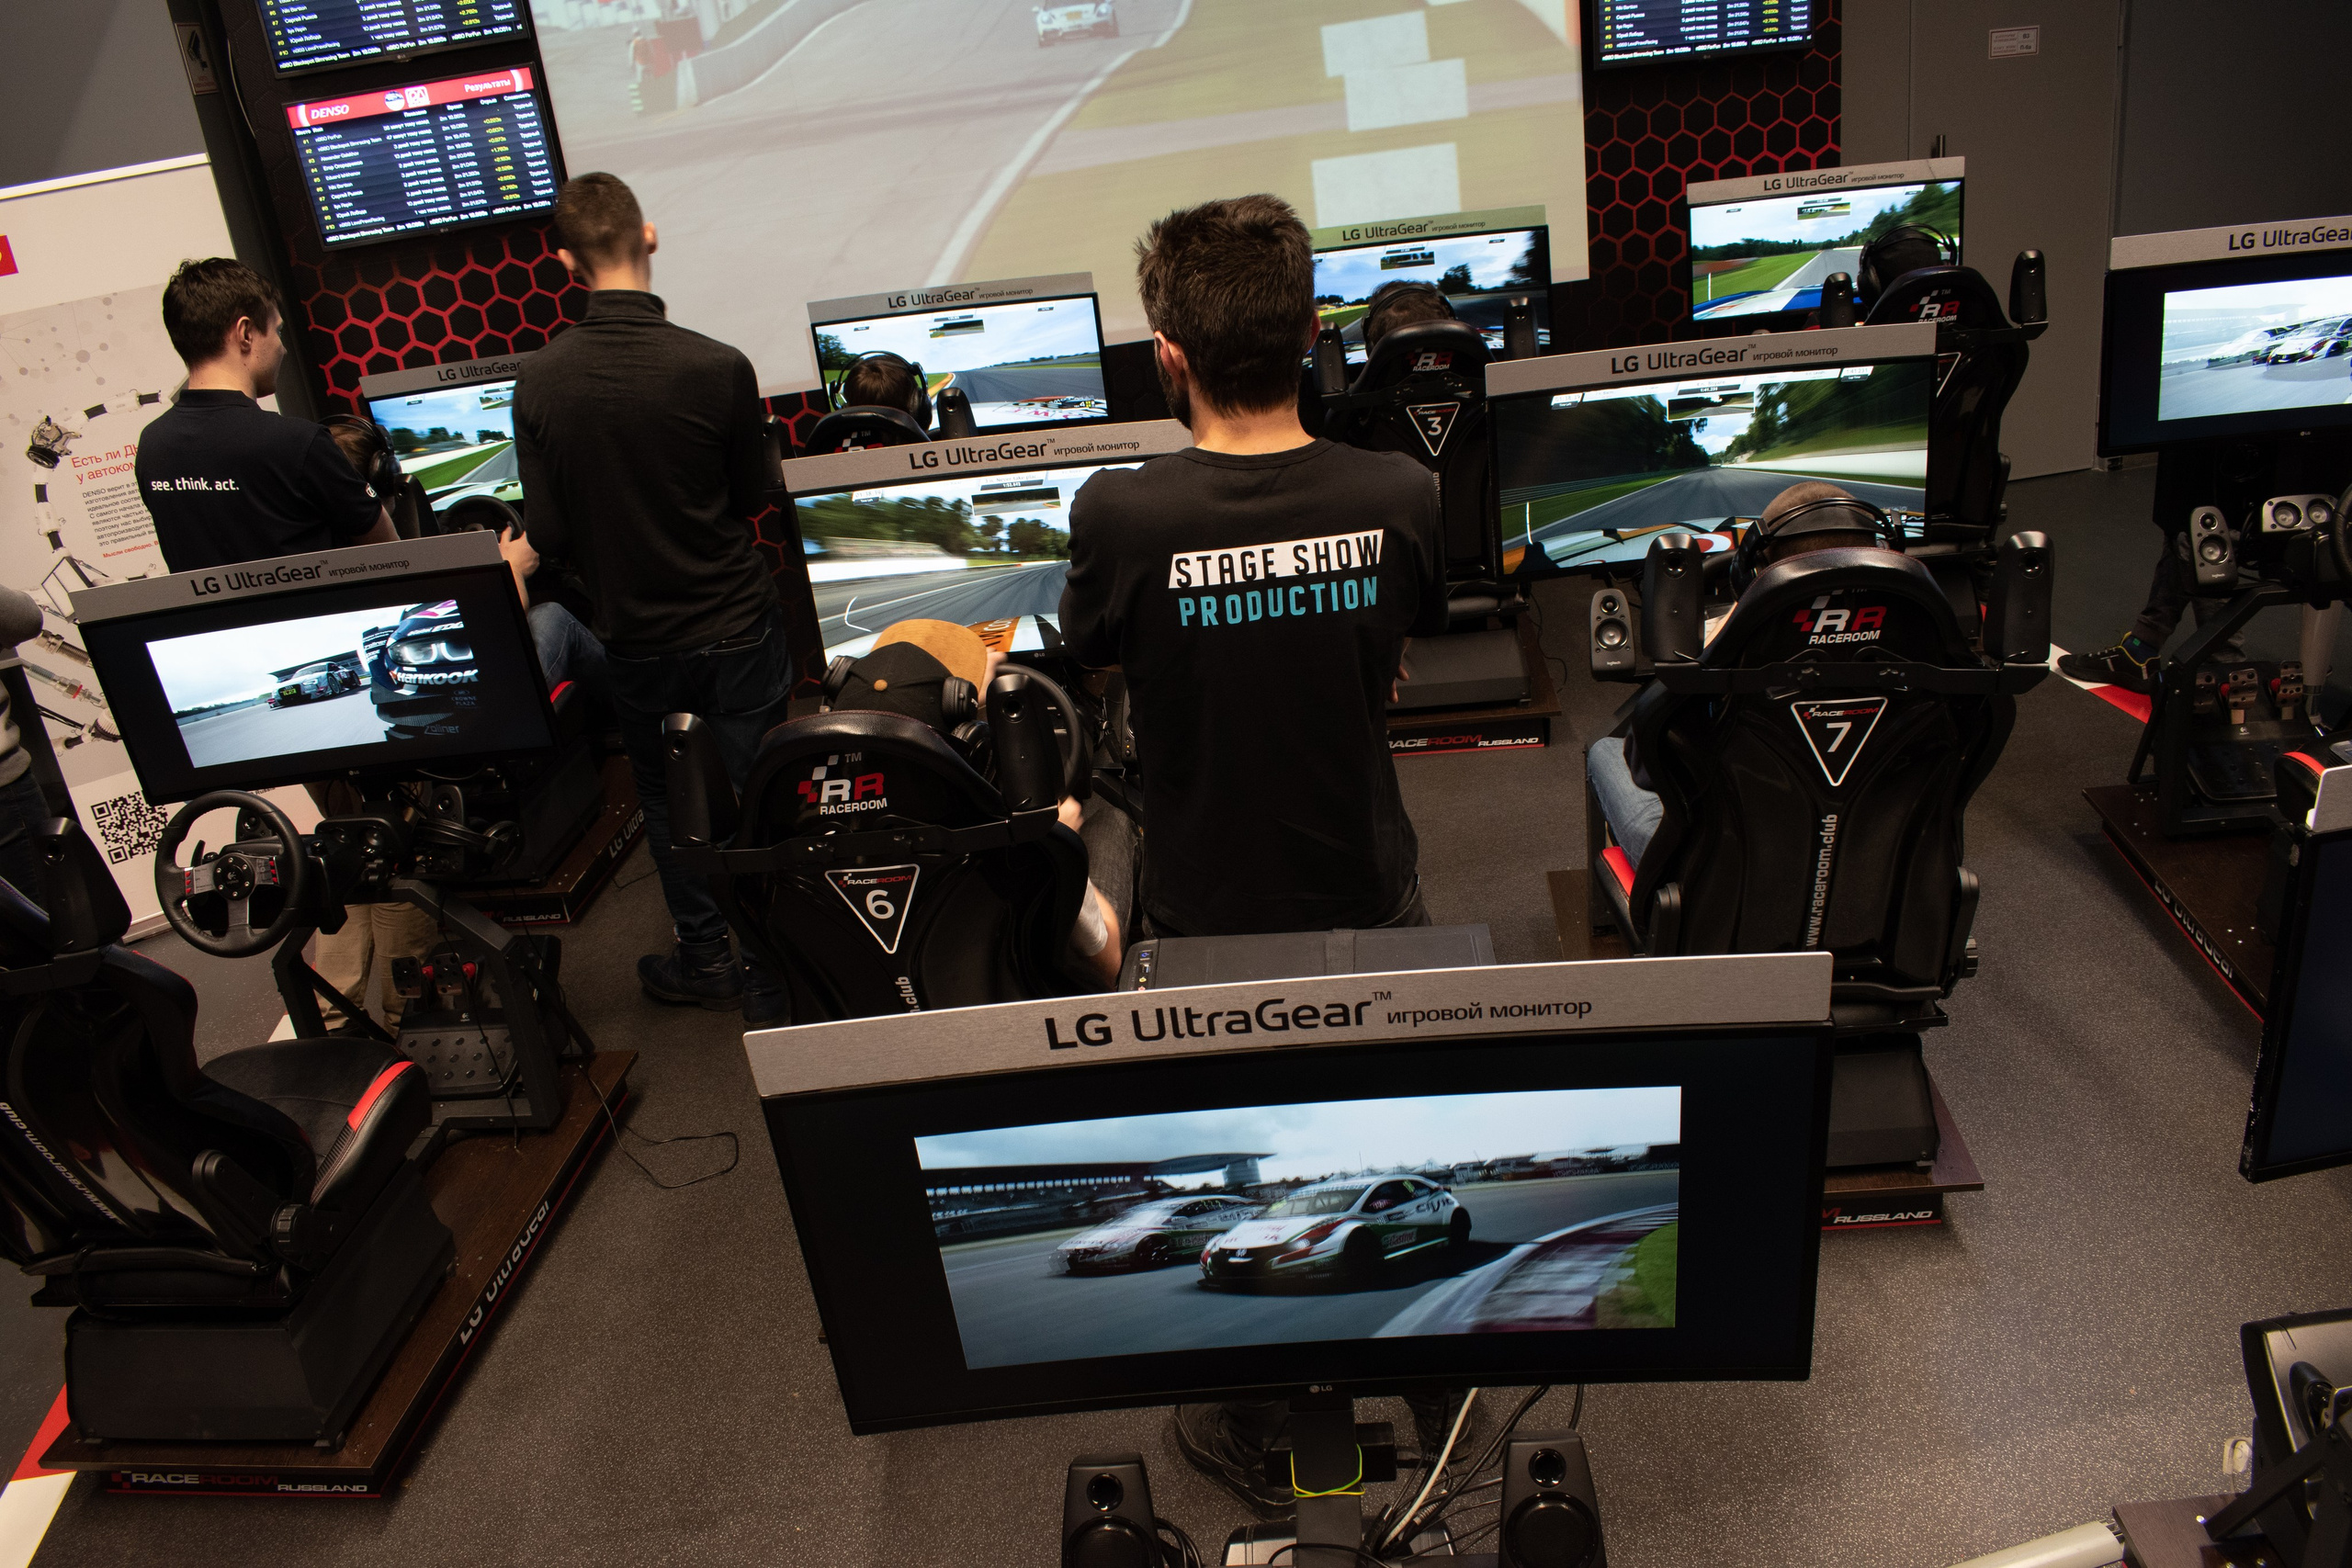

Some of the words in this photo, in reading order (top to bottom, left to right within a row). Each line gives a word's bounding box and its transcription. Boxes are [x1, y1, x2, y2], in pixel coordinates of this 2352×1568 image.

[463, 79, 511, 93] Результаты
[311, 104, 350, 119] DENSO
[1764, 178, 1781, 191] LG
[1851, 174, 1877, 184] игровой
[1877, 172, 1905, 181] монитор
[1342, 229, 1361, 242] LG
[1431, 223, 1457, 232] игровой
[1457, 220, 1487, 231] монитор
[2228, 232, 2256, 251] LG
[888, 296, 907, 309] LG
[978, 289, 1005, 300] игровой
[1005, 287, 1034, 298] монитор
[1413, 364, 1450, 372] RACEROOM
[1611, 355, 1639, 375] LG
[1753, 347, 1793, 363] игровой
[1794, 345, 1838, 359] монитор
[437, 368, 458, 382] LG
[1427, 416, 1442, 436] 3
[71, 455, 103, 468] Есть
[105, 450, 122, 462] ли
[909, 450, 939, 471] LG
[1053, 444, 1095, 458] игровой
[1096, 440, 1140, 453] монитор
[75, 473, 85, 486] у
[151, 479, 175, 492] see.
[175, 477, 213, 492] think.
[214, 478, 240, 492] act.
[82, 488, 107, 499] DENSO
[107, 483, 125, 494] верит
[85, 491, 128, 506] изготовления
[86, 500, 120, 513] идеальное
[96, 508, 119, 519] самого
[119, 502, 141, 513] начала
[91, 514, 121, 526] являются
[121, 510, 144, 521] частью
[94, 523, 120, 534] поэтому
[120, 519, 132, 527] нас
[109, 530, 147, 544] правильный
[103, 549, 124, 558] Мысли
[1175, 547, 1277, 589] STAGE
[1293, 534, 1378, 576] SHOW
[190, 576, 221, 597] LG
[328, 562, 368, 580] игровой
[368, 557, 411, 574] монитор
[1179, 576, 1377, 627] PRODUCTION
[1808, 630, 1882, 645] RACEROOM
[1812, 707, 1879, 718] RACEROOM
[1477, 737, 1540, 747] RUSSLAND
[1826, 721, 1852, 753] 7
[844, 751, 863, 763] TM
[820, 797, 888, 816] RACEROOM
[608, 839, 624, 859] LG
[847, 874, 912, 886] RACEROOM
[1806, 814, 1838, 947] www.raceroom.club
[865, 889, 895, 919] 6
[1045, 1013, 1114, 1051] LG
[1386, 1004, 1484, 1029] игровой
[1489, 998, 1593, 1021] монитор
[1834, 1211, 1933, 1224] RUSSLAND
[1320, 1385, 1334, 1393] LG
[131, 1472, 279, 1486] RACEROOM
[277, 1484, 368, 1493] RUSSLAND
